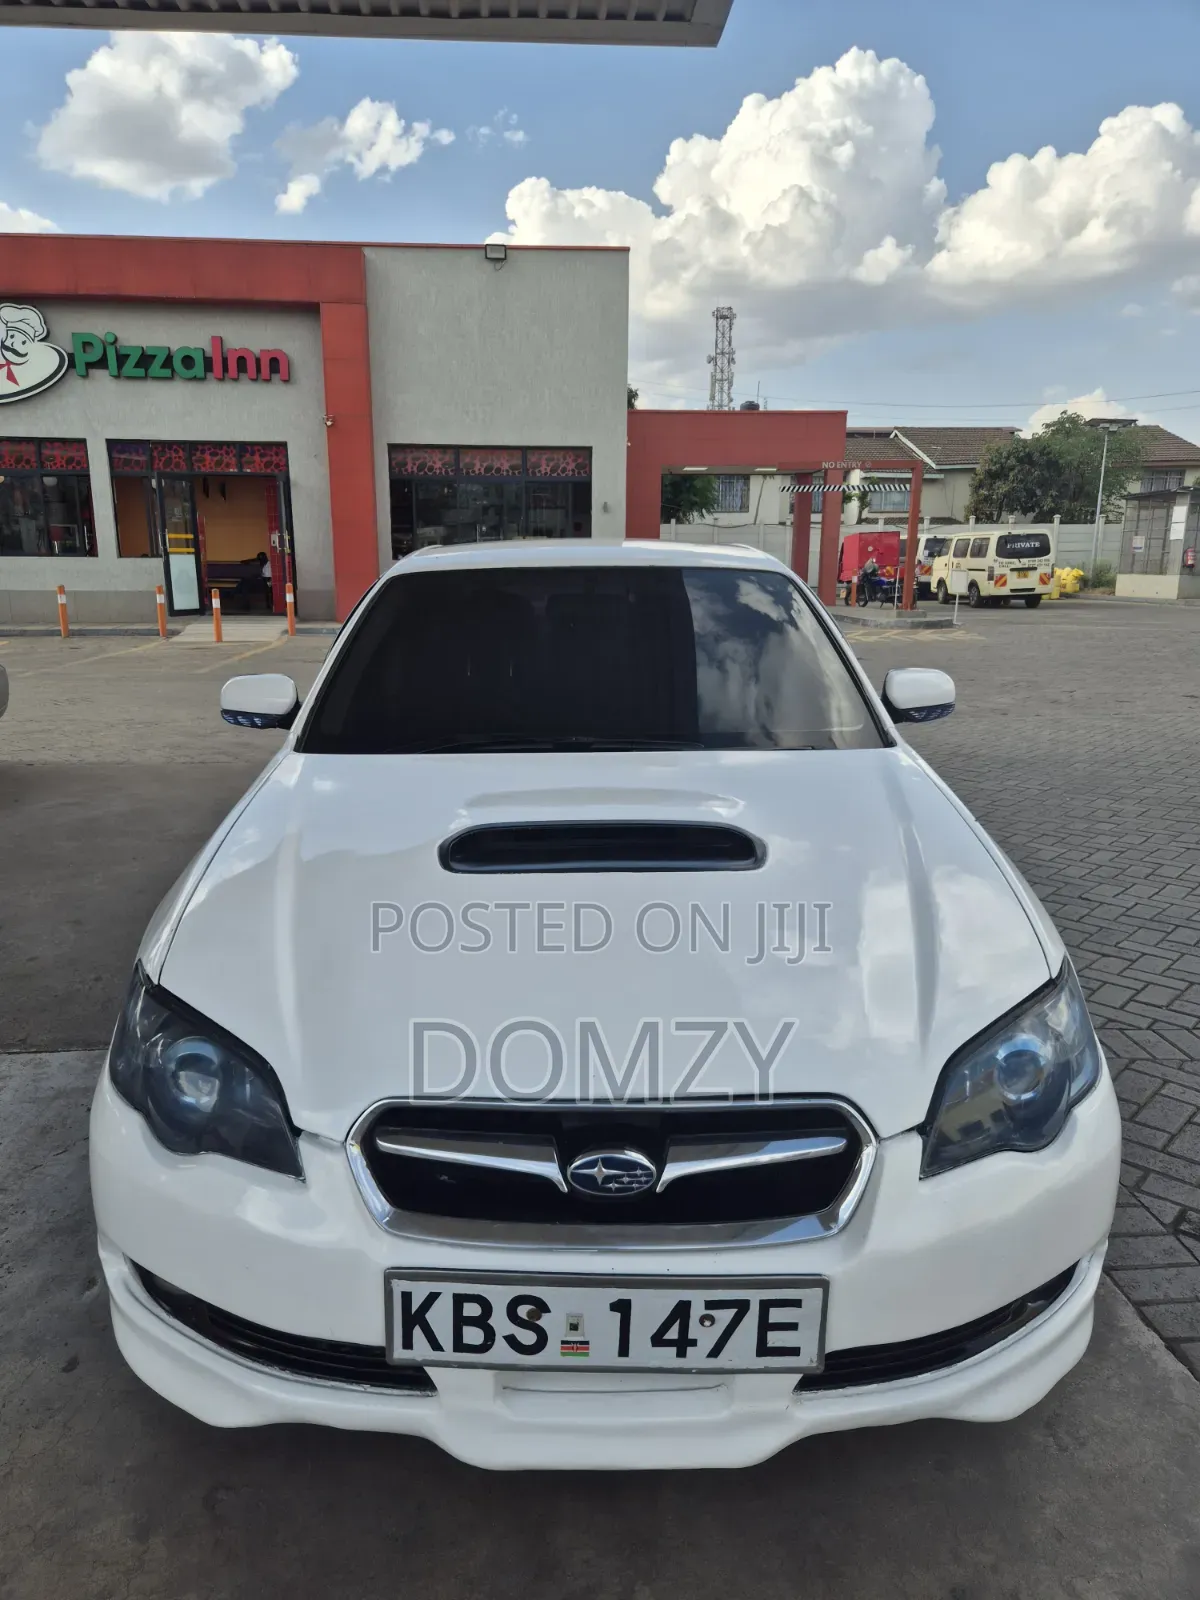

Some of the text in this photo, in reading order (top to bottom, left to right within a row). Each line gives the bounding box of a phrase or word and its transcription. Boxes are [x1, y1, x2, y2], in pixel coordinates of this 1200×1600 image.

[822, 461, 862, 469] NO ENTRY
[400, 1290, 803, 1359] KBS 147E
